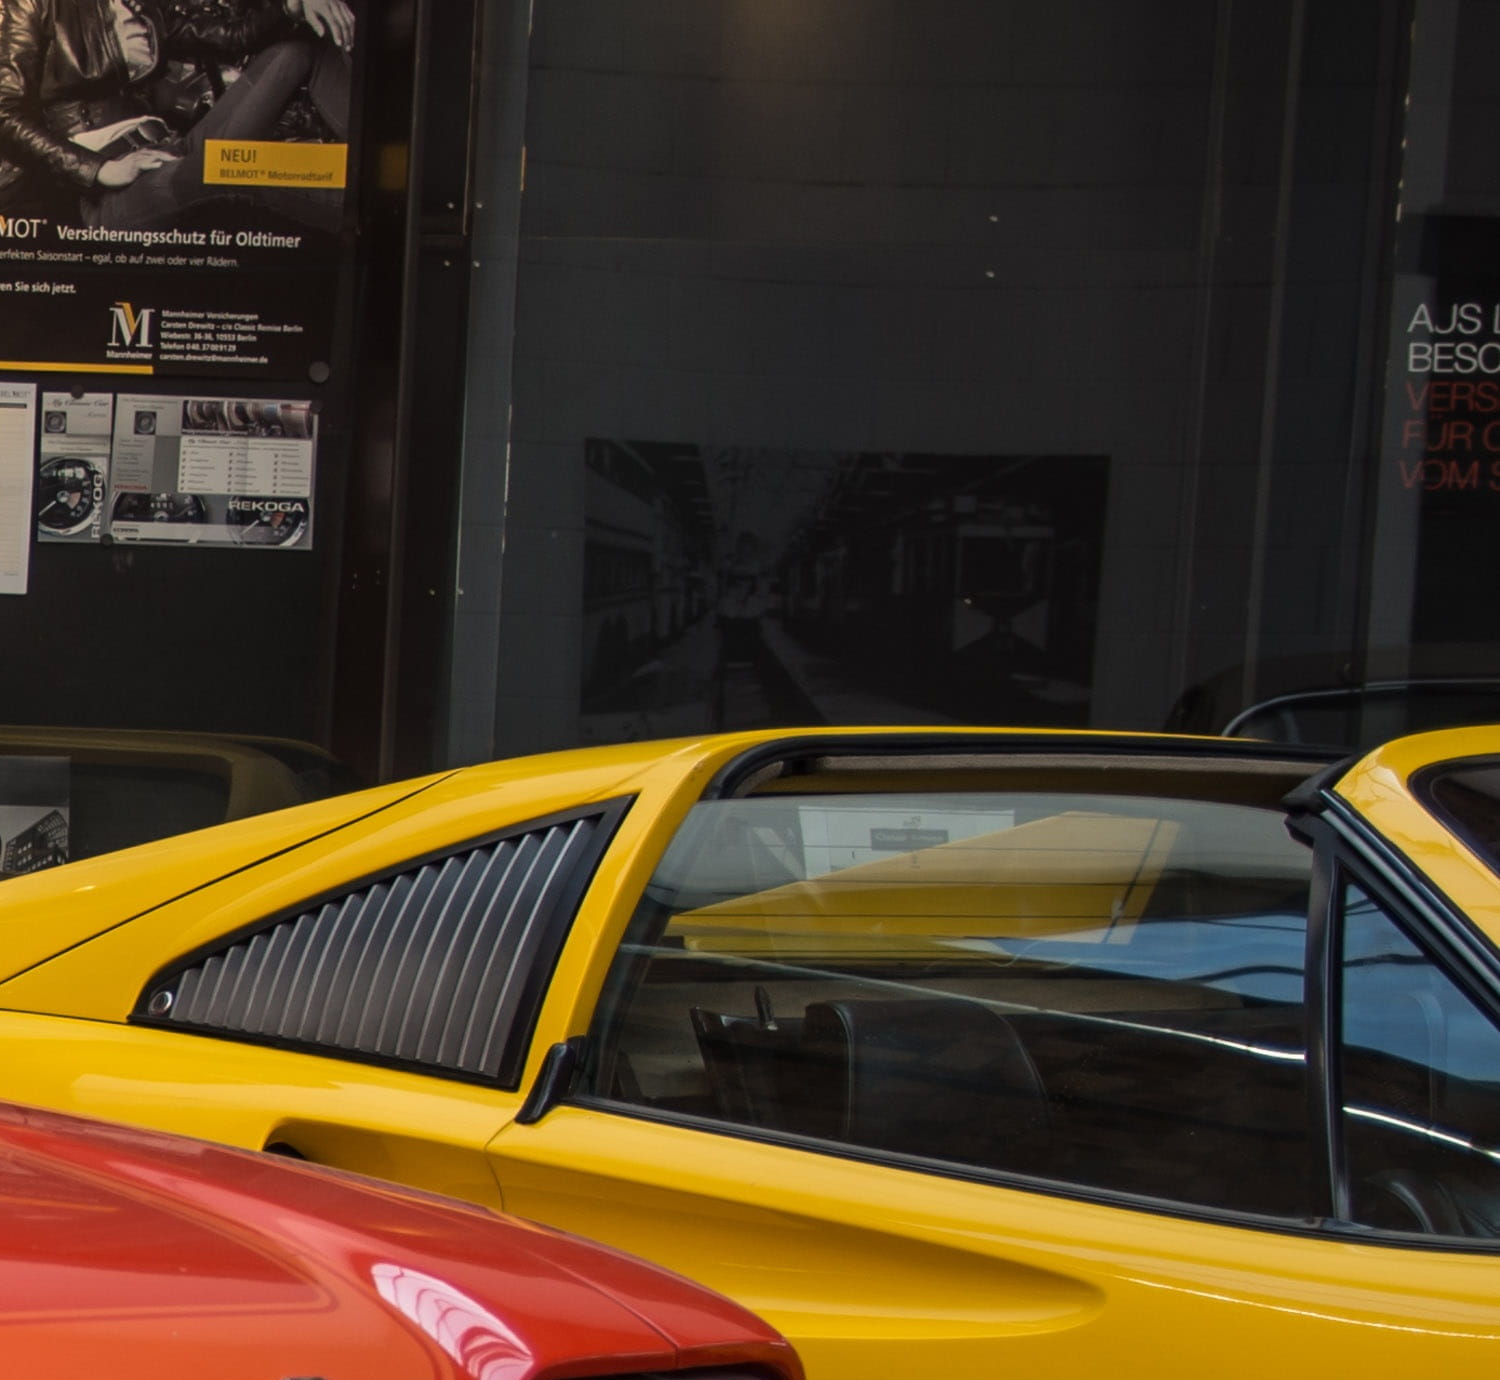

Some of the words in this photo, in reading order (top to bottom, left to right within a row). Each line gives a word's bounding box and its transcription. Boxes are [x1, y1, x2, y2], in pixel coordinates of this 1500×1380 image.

[220, 149, 257, 164] NEU!
[267, 170, 334, 182] Motorradtarif
[56, 225, 206, 248] Versicherungsschutz
[209, 229, 234, 247] für
[235, 230, 302, 249] Oldtimer
[36, 250, 83, 263] Saisonstart
[114, 252, 128, 264] ob
[128, 253, 145, 265] auf
[145, 254, 166, 266] zwei
[166, 255, 188, 267] oder
[14, 281, 30, 293] Sie
[31, 281, 51, 294] sich
[52, 281, 77, 295] jetzt.
[1406, 302, 1483, 335] AJS
[106, 350, 153, 360] Mannheimer
[227, 499, 305, 514] REKOGA
